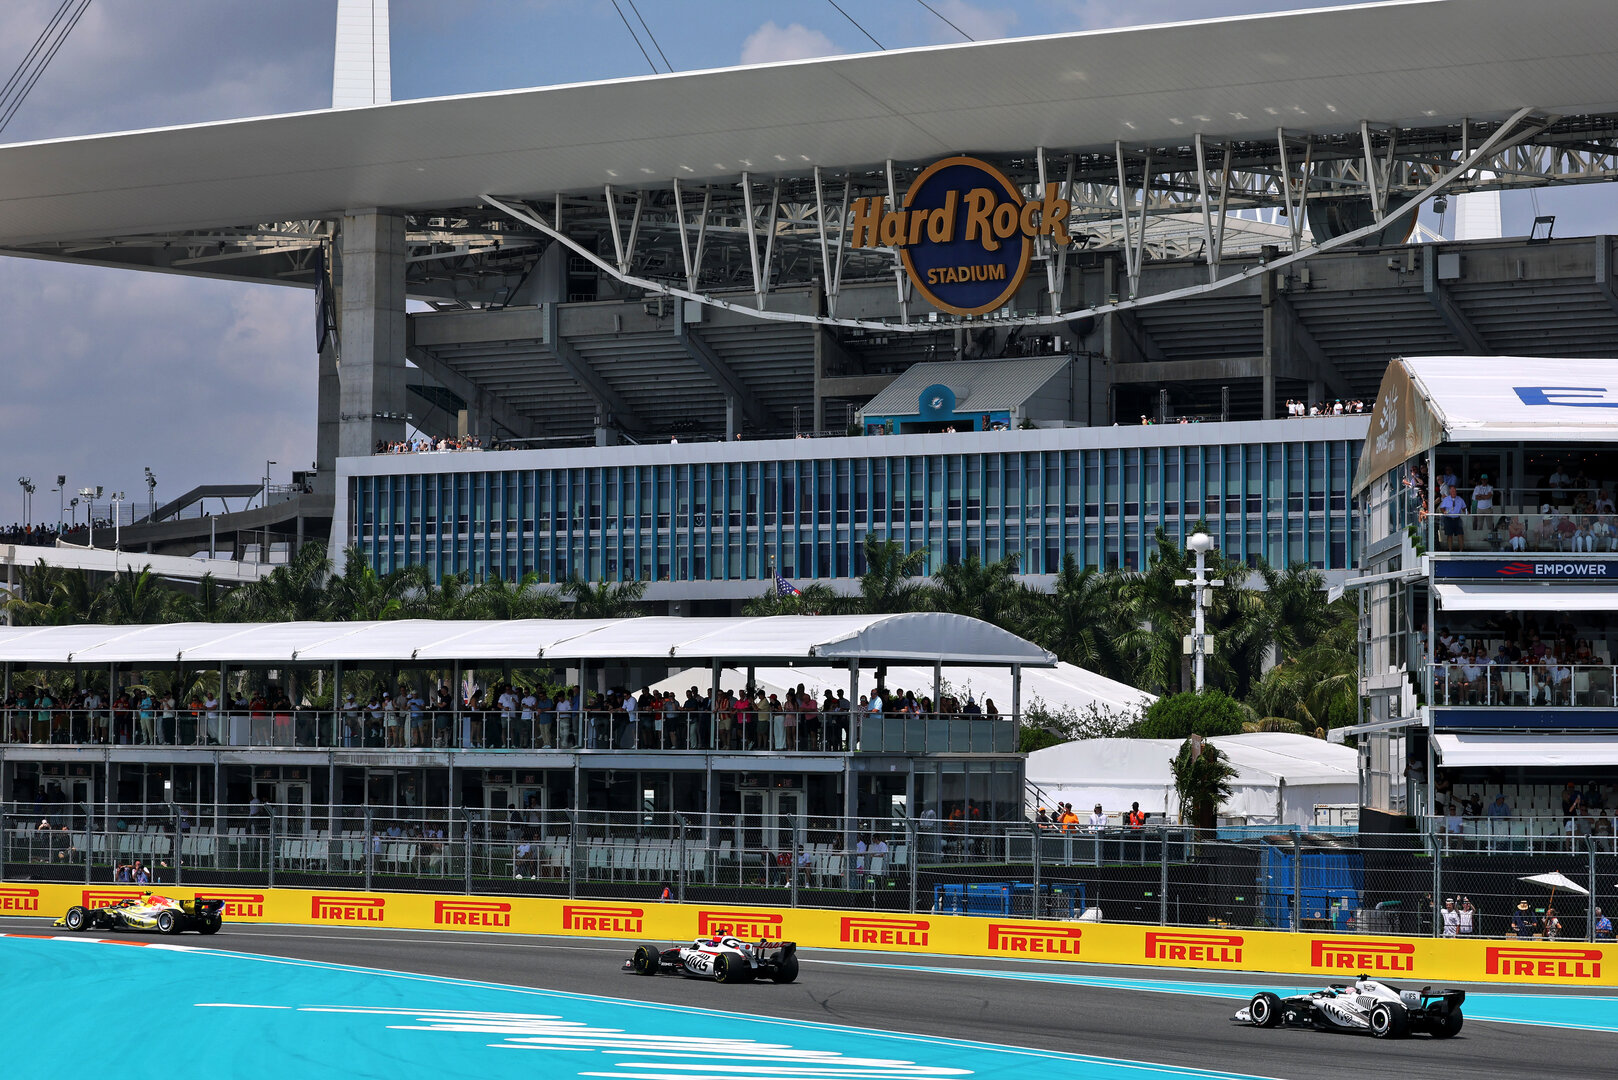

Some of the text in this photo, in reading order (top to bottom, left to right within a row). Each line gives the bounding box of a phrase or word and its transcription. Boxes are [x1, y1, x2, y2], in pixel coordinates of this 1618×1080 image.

[850, 182, 1072, 252] Hard Rock
[927, 263, 1007, 285] STADIUM
[1535, 564, 1607, 575] EMPOWER
[312, 896, 386, 922] PIRELLI
[435, 900, 512, 927] PIRELLI
[563, 905, 644, 933] PIRELLI
[698, 911, 784, 940] PIRELLI
[840, 916, 930, 947] PIRELLI
[988, 923, 1082, 955] PIRELLI
[1145, 931, 1245, 963] PIRELLI
[1311, 939, 1416, 971] PIRELLI
[1486, 946, 1603, 978] PIRELLI
